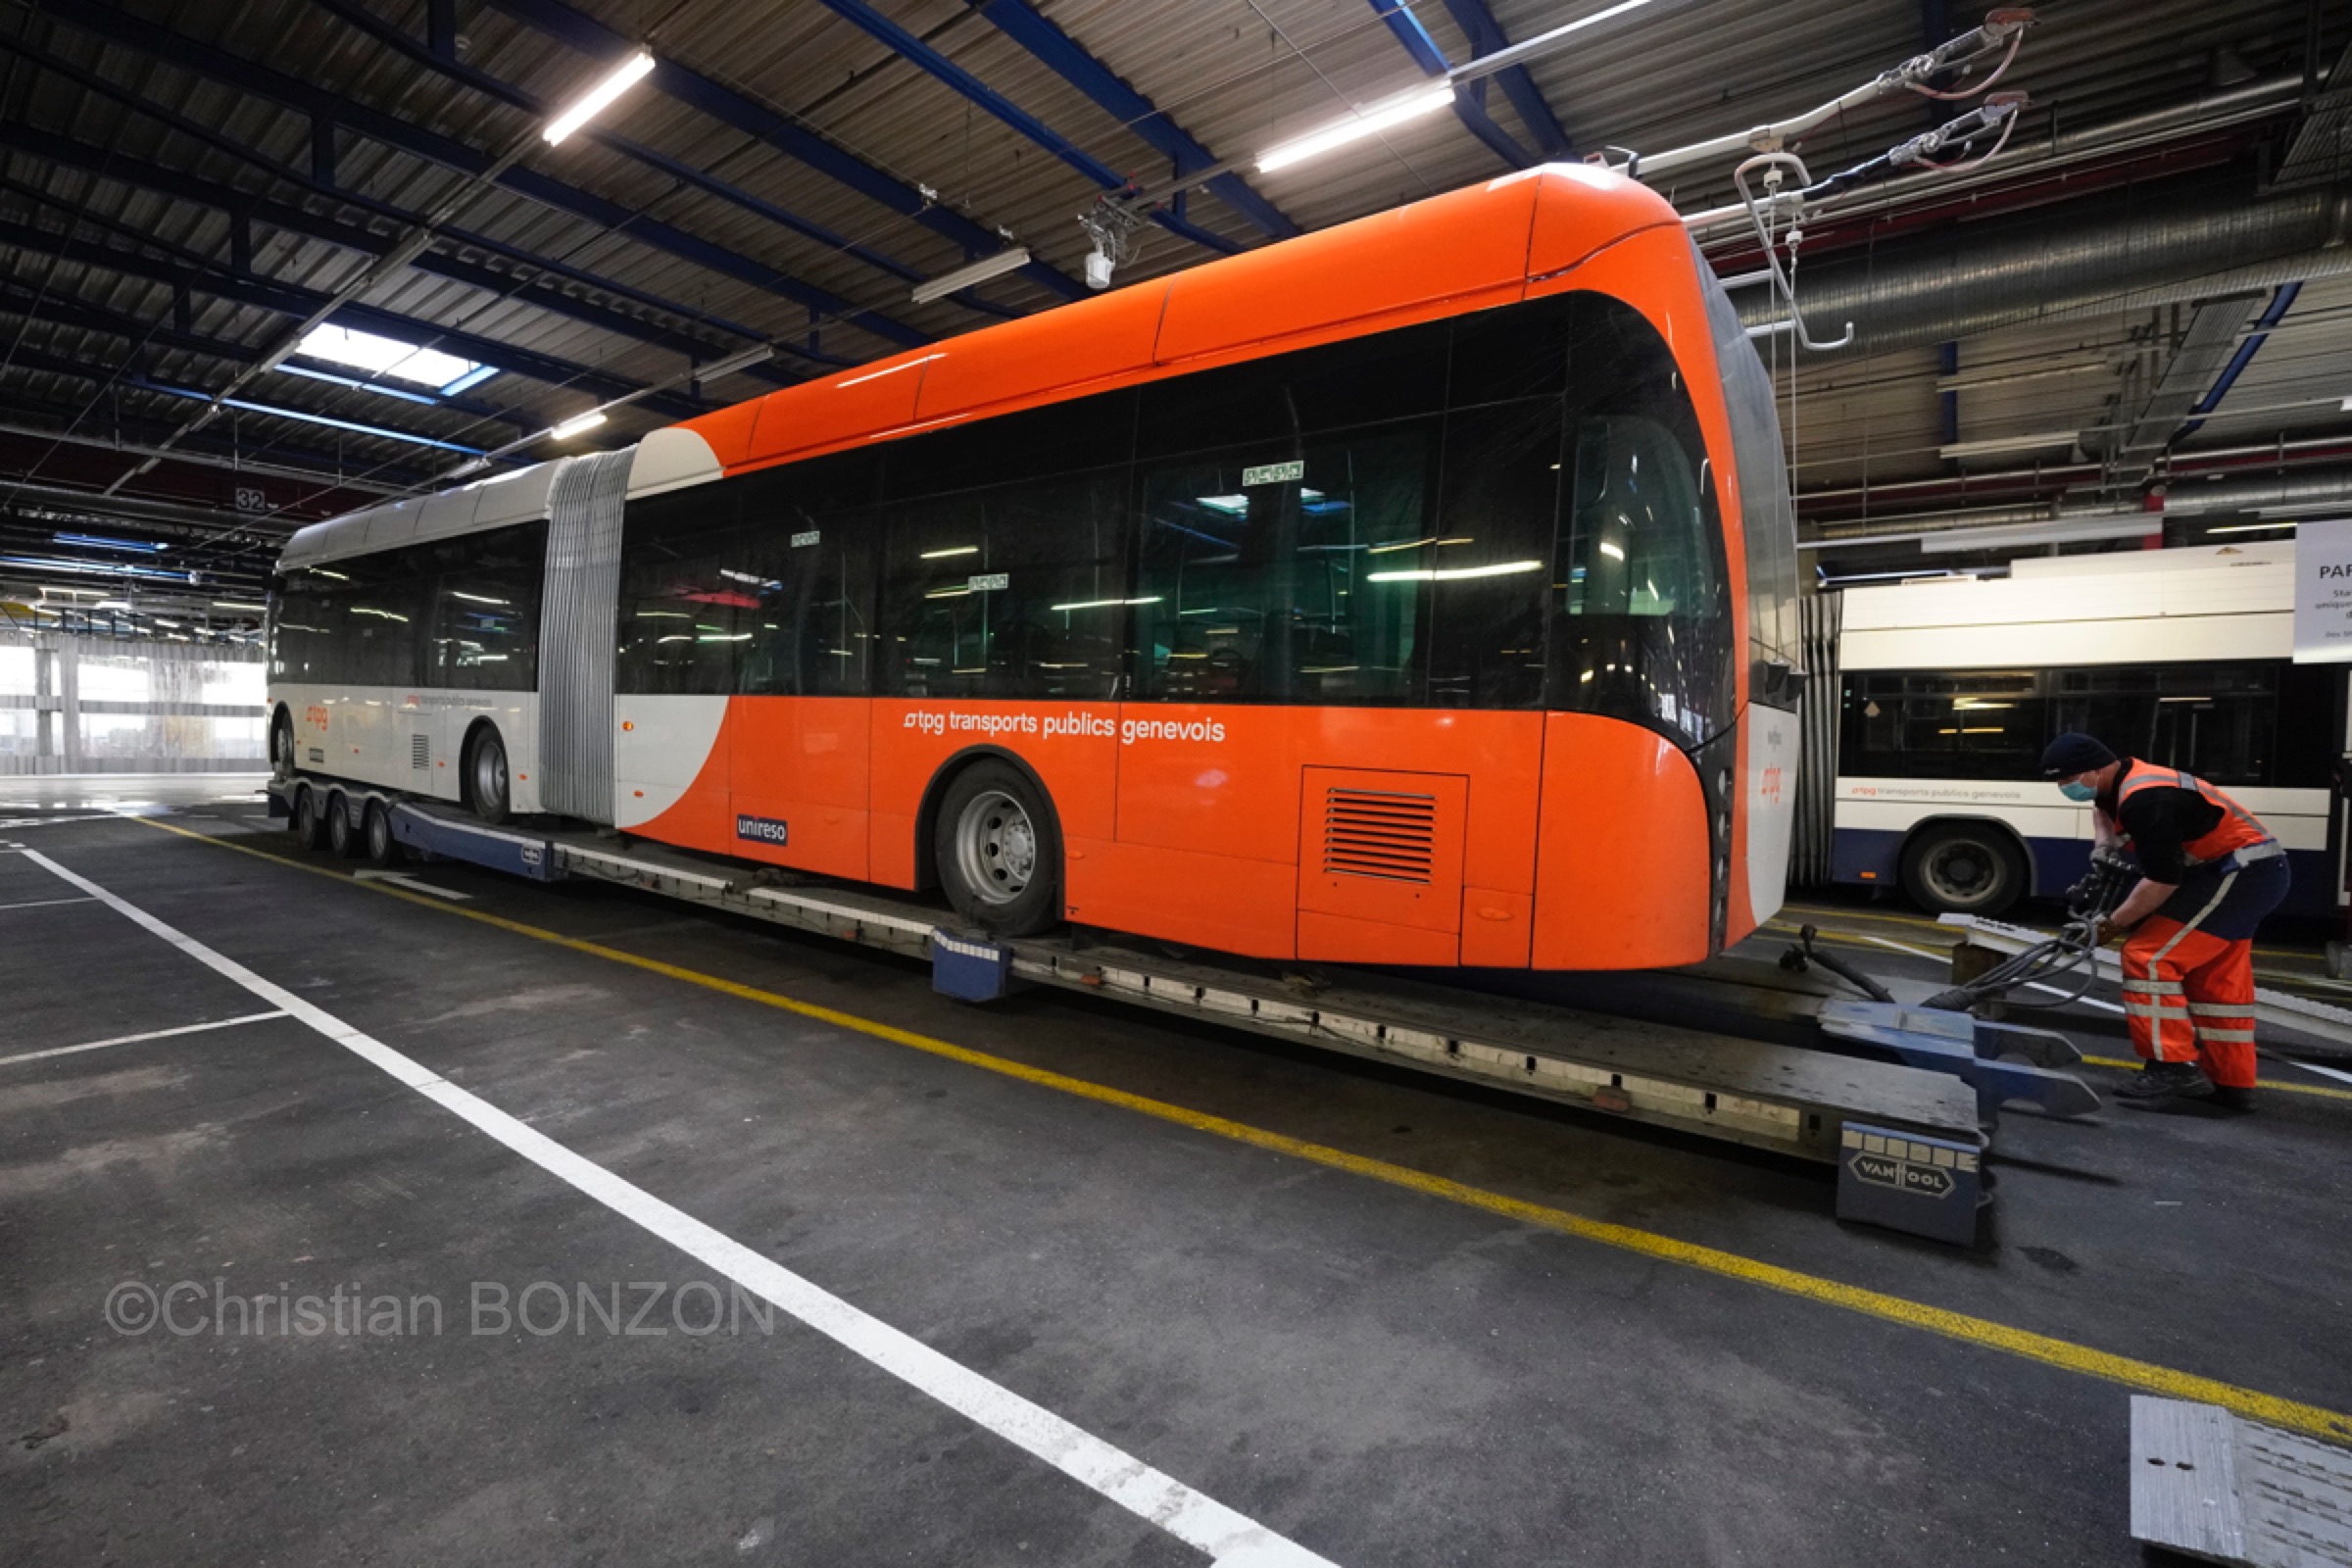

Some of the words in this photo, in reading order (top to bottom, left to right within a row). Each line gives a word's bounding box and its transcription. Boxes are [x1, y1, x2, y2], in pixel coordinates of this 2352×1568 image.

[950, 710, 1037, 737] transports
[1043, 710, 1115, 740] publics
[1121, 716, 1225, 746] genevois
[738, 815, 786, 841] unireso
